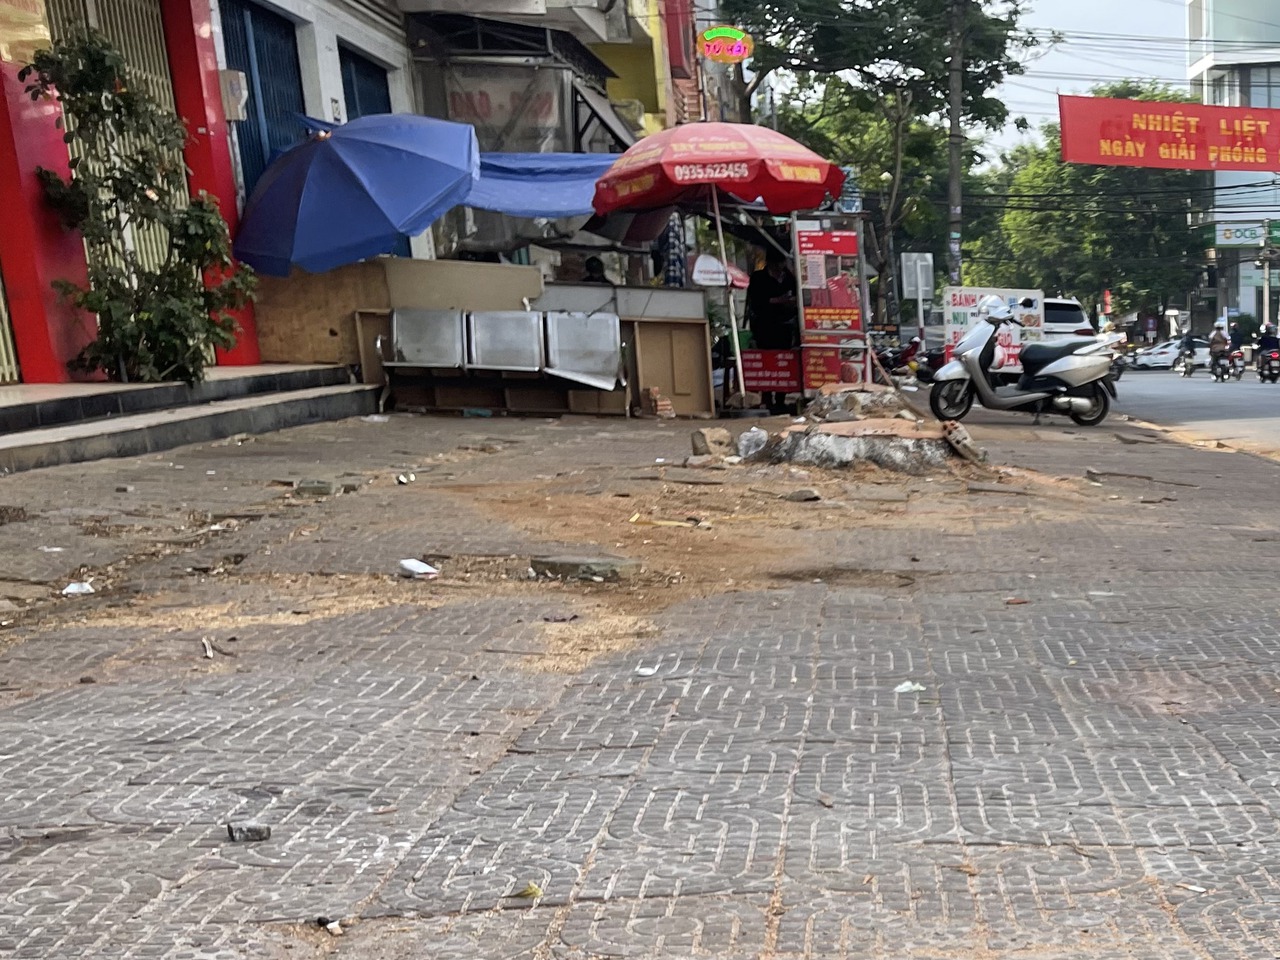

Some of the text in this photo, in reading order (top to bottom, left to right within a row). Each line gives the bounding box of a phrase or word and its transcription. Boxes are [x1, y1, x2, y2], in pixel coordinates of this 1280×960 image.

[1132, 111, 1200, 137] NHIỆT
[1219, 114, 1270, 141] LIỆT
[1099, 134, 1146, 157] NGÀY
[1158, 137, 1197, 160] GIẢI
[1208, 141, 1267, 163] PHÓNG
[1235, 228, 1257, 239] OCB
[951, 289, 977, 307] BÁNH
